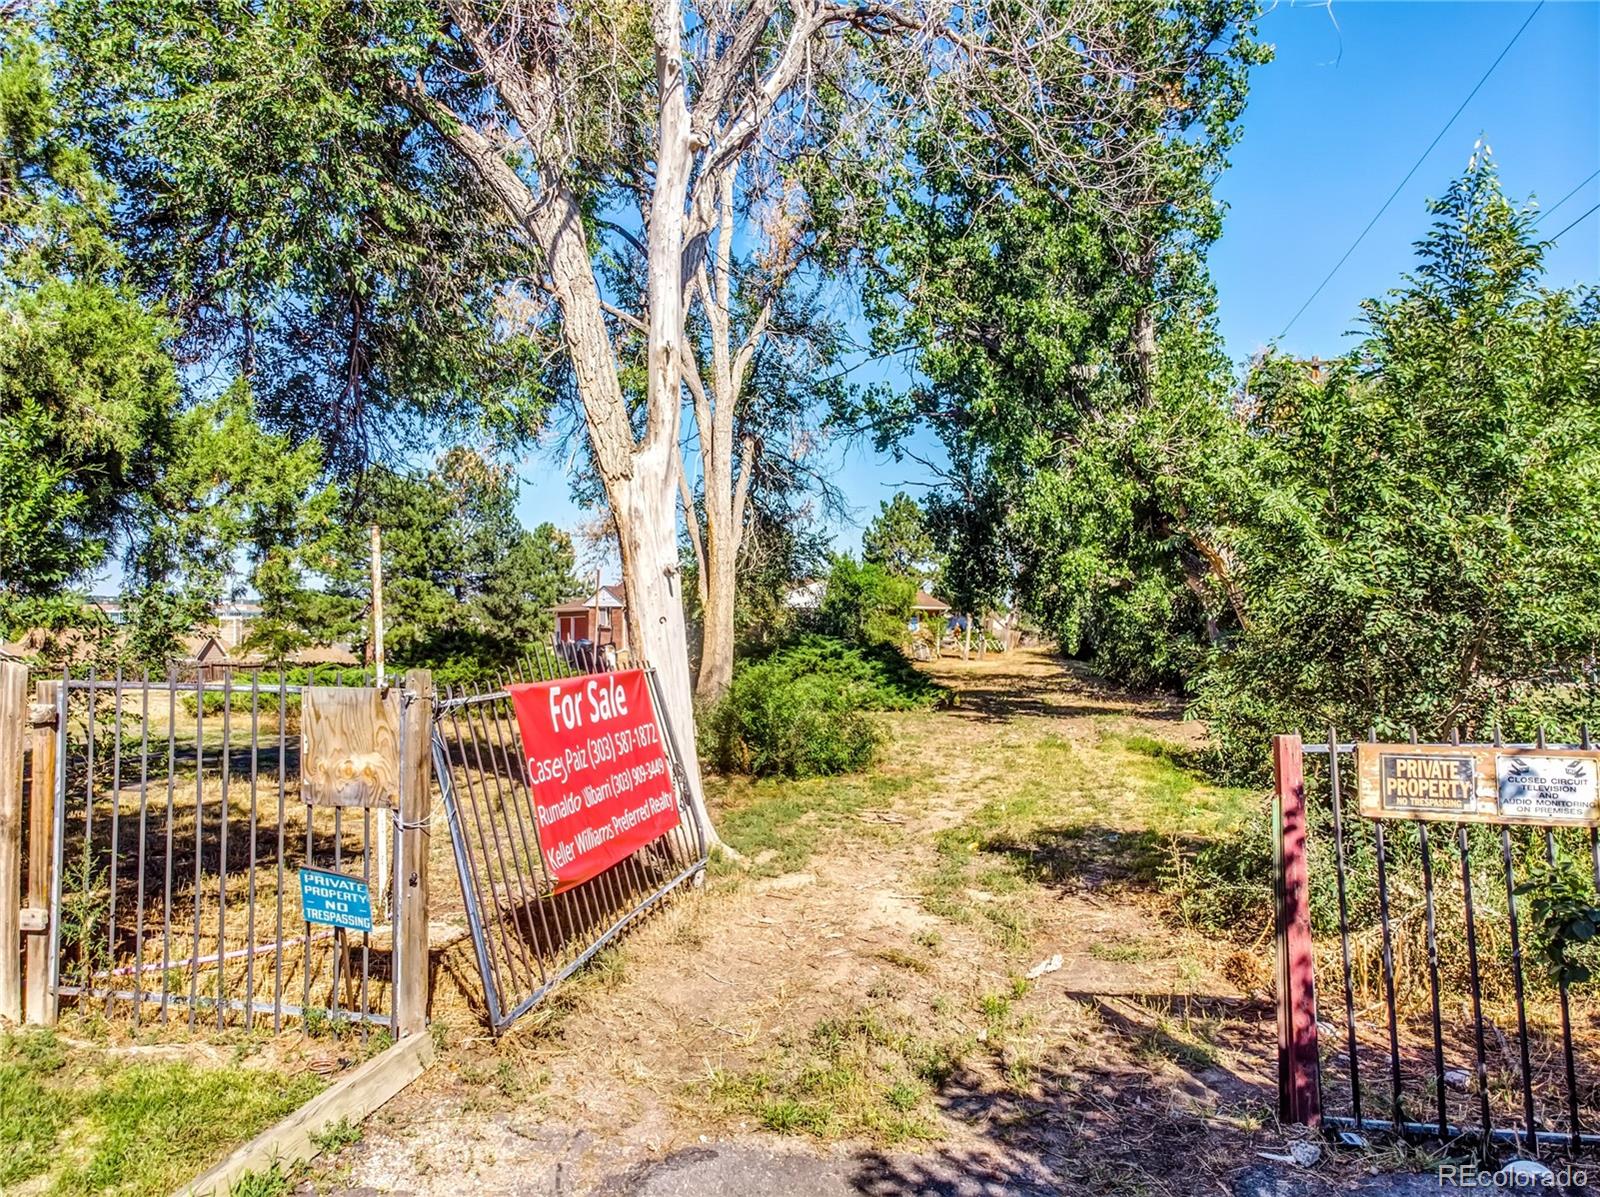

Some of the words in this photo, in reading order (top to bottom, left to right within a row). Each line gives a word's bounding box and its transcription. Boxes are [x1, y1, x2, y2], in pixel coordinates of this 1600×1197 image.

[549, 686, 582, 733] For
[586, 675, 629, 723] Sale
[565, 745, 589, 775] Paiz
[587, 733, 617, 769] (303)
[614, 722, 658, 756] 587-1872
[1395, 759, 1461, 779] PRIVATE
[1386, 777, 1471, 799] PROPERTY
[1507, 776, 1547, 784] CLOSED
[1522, 784, 1577, 793] TELEVISION
[538, 792, 582, 827] Rumaldo
[610, 768, 634, 799] (303)
[632, 757, 665, 786] 909-3449
[1396, 797, 1408, 806] NO
[1410, 797, 1463, 808] TRESPASSING
[1534, 806, 1583, 816] PREMISES
[1536, 799, 1597, 809] MONITORING
[546, 838, 575, 870] Keller
[574, 826, 614, 856] Williams
[611, 797, 651, 837] Preferred
[649, 790, 675, 818] Realty
[303, 874, 367, 893] PRIVATE
[303, 885, 368, 904] PROPERTY
[325, 900, 349, 912] NO
[305, 907, 371, 929] TRESPASSING
